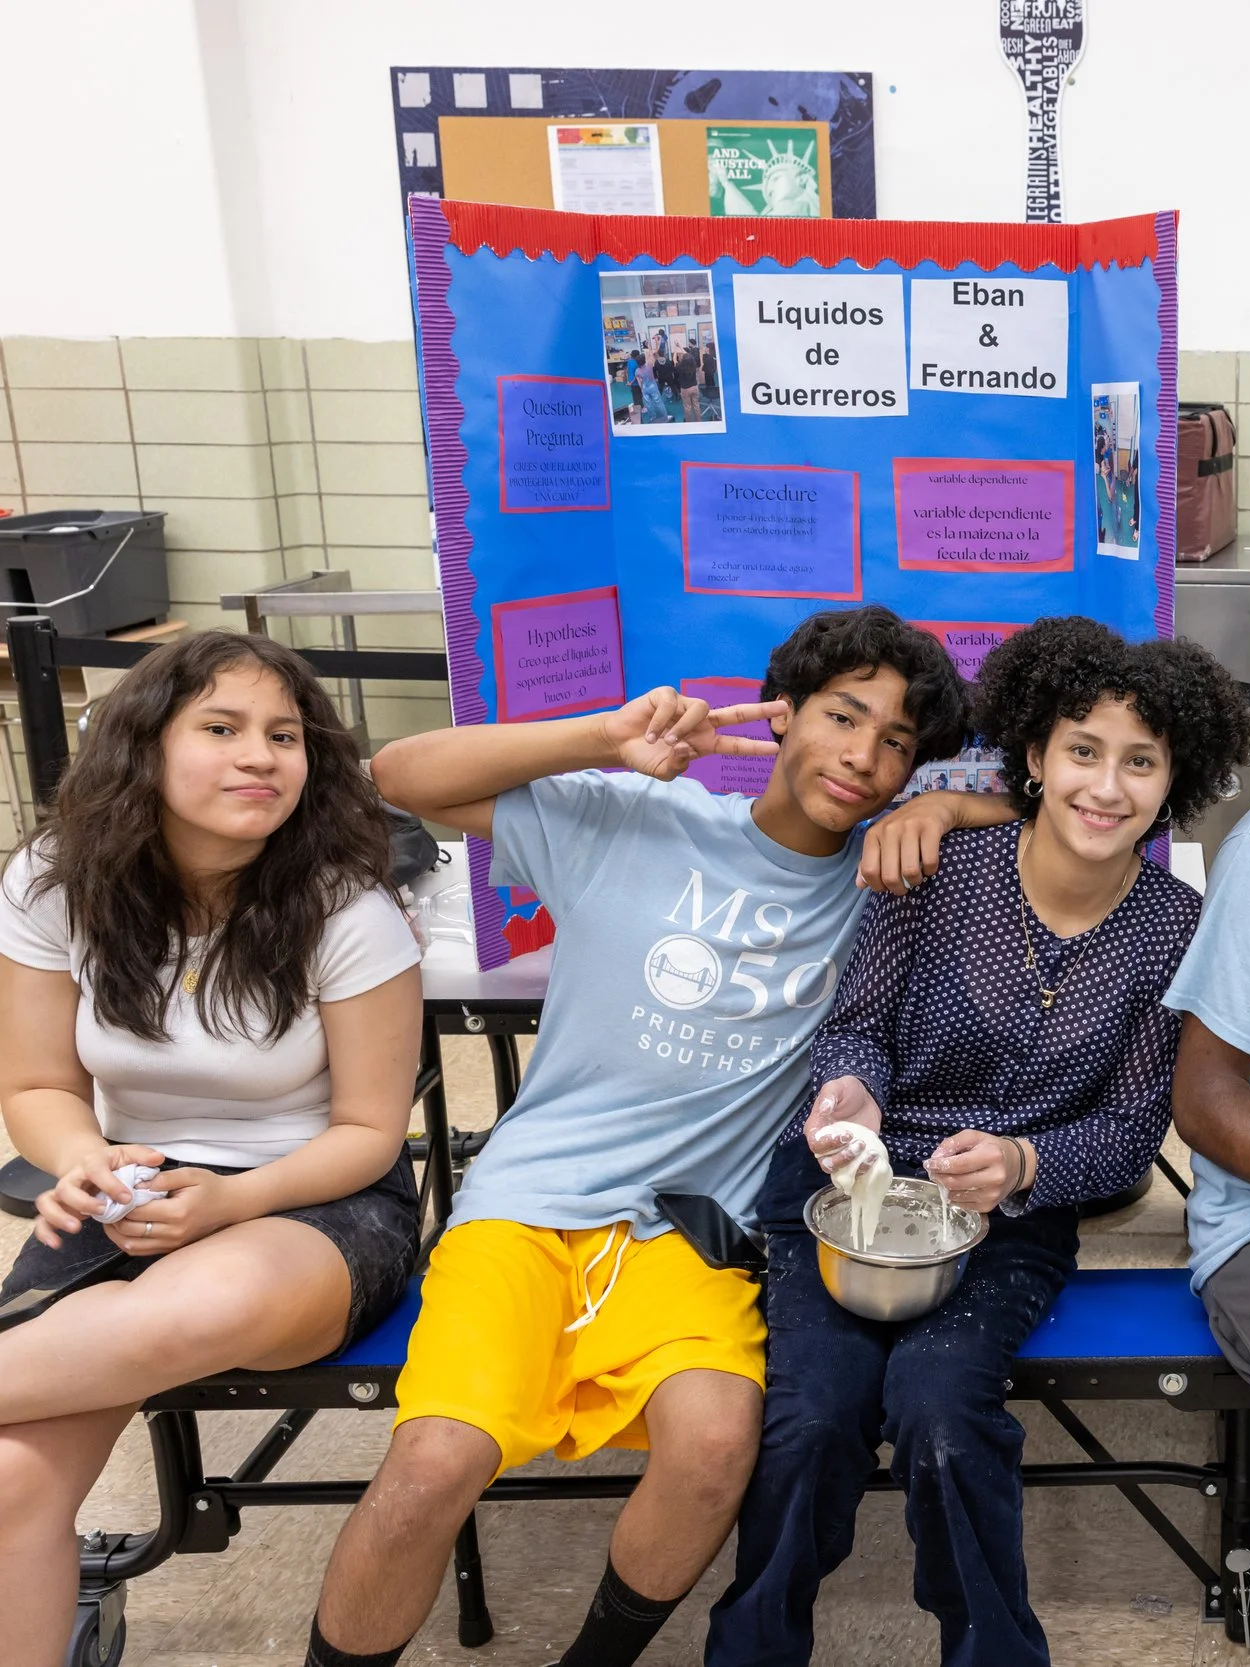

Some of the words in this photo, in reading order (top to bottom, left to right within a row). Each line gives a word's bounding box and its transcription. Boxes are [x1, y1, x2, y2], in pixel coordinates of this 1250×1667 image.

[1052, 18, 1073, 29] EAT
[1025, 34, 1043, 148] HEALTHY
[1043, 36, 1058, 148] VEGETABLES
[712, 148, 740, 158] AND
[727, 169, 752, 179] ALL
[952, 281, 1025, 306] Eban
[758, 301, 884, 330] Líquidos
[978, 323, 999, 348] &
[805, 343, 840, 366] de
[921, 363, 1057, 390] Fernando
[751, 381, 897, 407] Guerreros
[523, 398, 582, 418] Question
[526, 429, 584, 451] Pregunta
[928, 474, 967, 484] variable
[968, 475, 1028, 486] dependiente
[724, 484, 818, 502] Procedure
[913, 505, 966, 519] variable
[969, 506, 1052, 523] dependiente
[926, 530, 942, 540] es
[944, 527, 956, 540] la
[958, 528, 1014, 541] maizena
[1016, 531, 1025, 541] o
[1028, 528, 1040, 541] la
[980, 547, 996, 561] de
[527, 622, 597, 647] Hypothesis
[662, 866, 793, 950] MS
[714, 951, 838, 1022] 50
[632, 1005, 716, 1046] PRIDE
[727, 1033, 763, 1051] OF
[774, 1036, 803, 1050] TH
